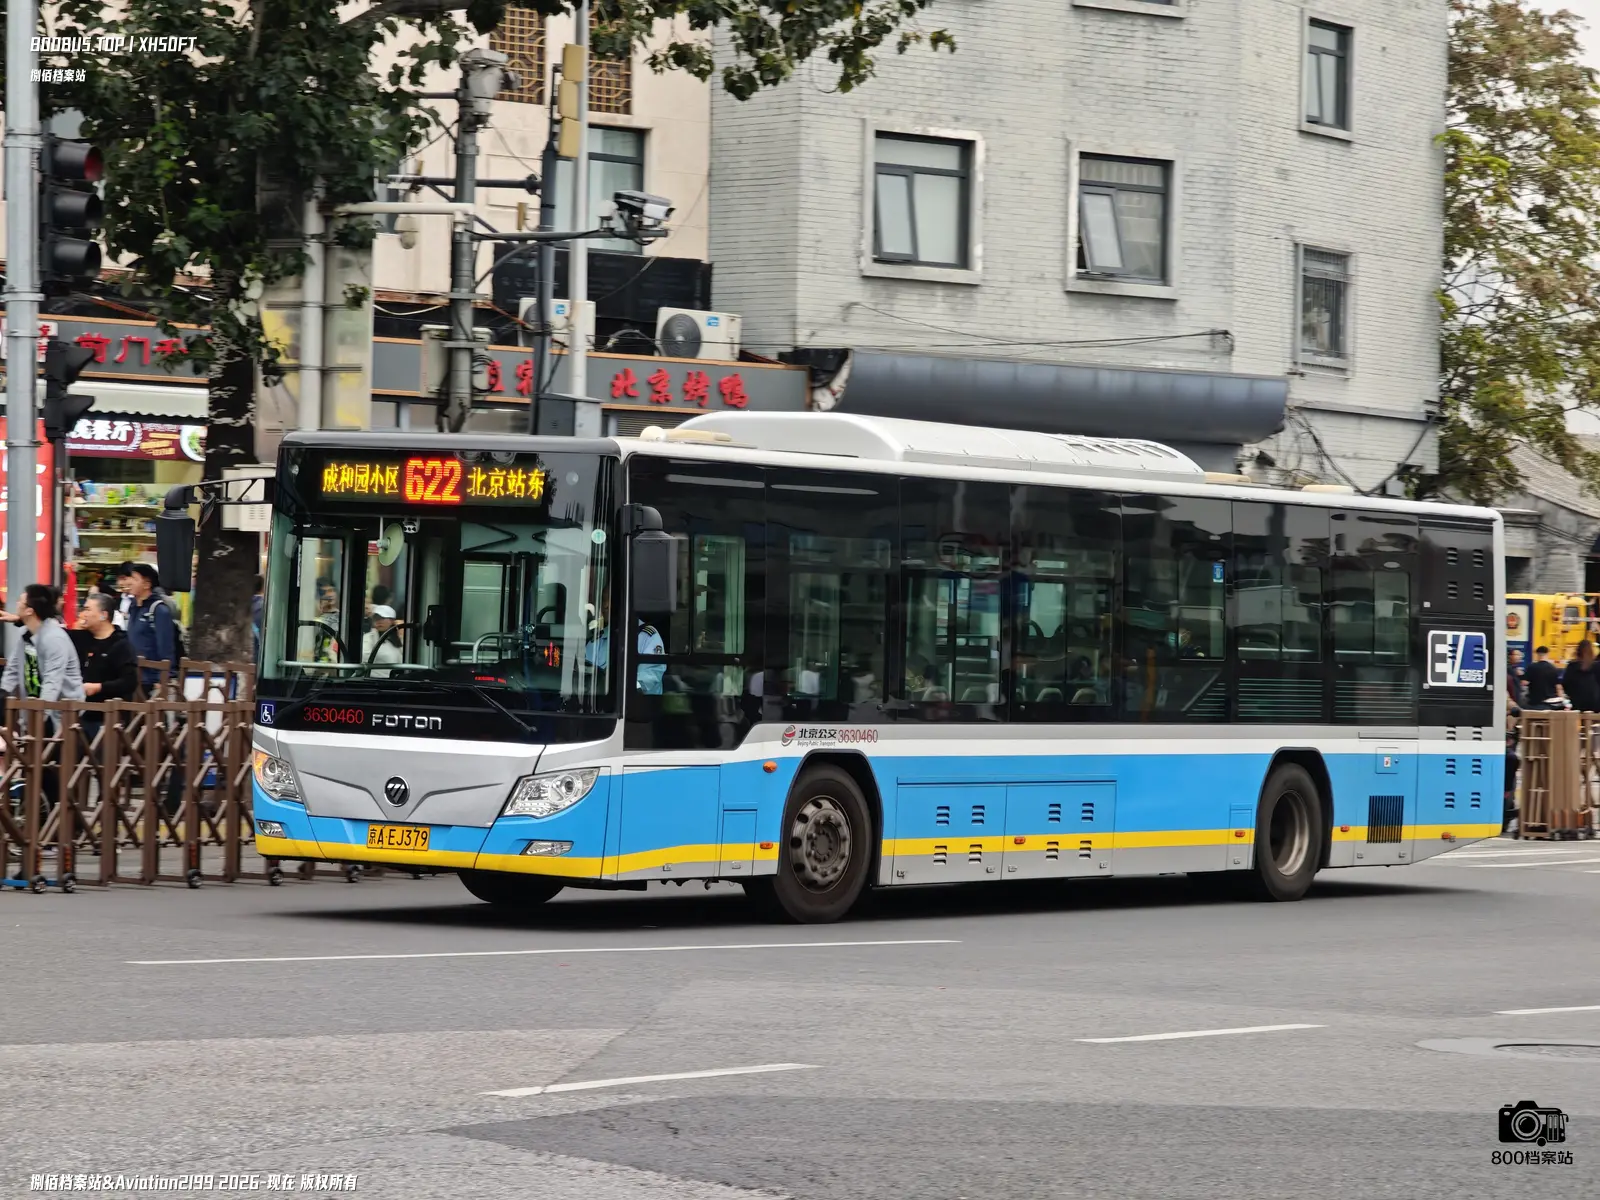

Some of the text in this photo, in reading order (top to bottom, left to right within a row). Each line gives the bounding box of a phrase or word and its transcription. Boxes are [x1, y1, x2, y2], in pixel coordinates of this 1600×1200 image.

[611, 367, 750, 409] 北京烤鸭
[322, 457, 545, 503] 成和园小区 622 北京站东
[303, 707, 365, 725] 3630460
[371, 713, 442, 730] FOTON
[798, 727, 879, 744] 北京公交 3630460
